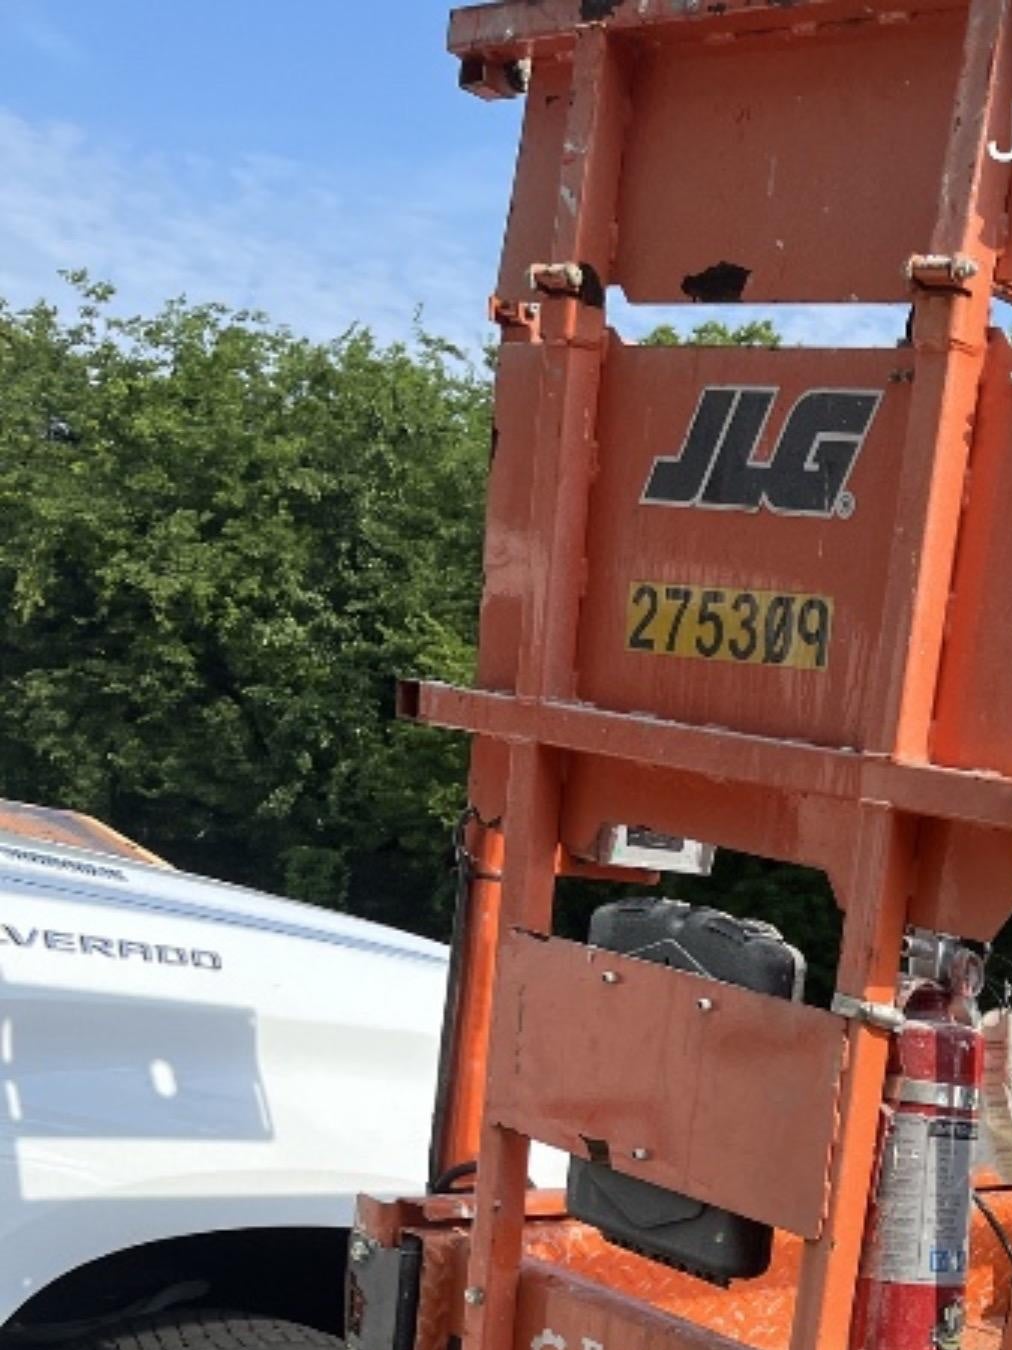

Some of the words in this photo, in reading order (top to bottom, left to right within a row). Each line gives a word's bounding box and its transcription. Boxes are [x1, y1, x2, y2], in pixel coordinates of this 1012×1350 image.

[639, 385, 885, 519] JLG
[628, 584, 830, 668] 275309
[0, 923, 223, 971] VERADO
